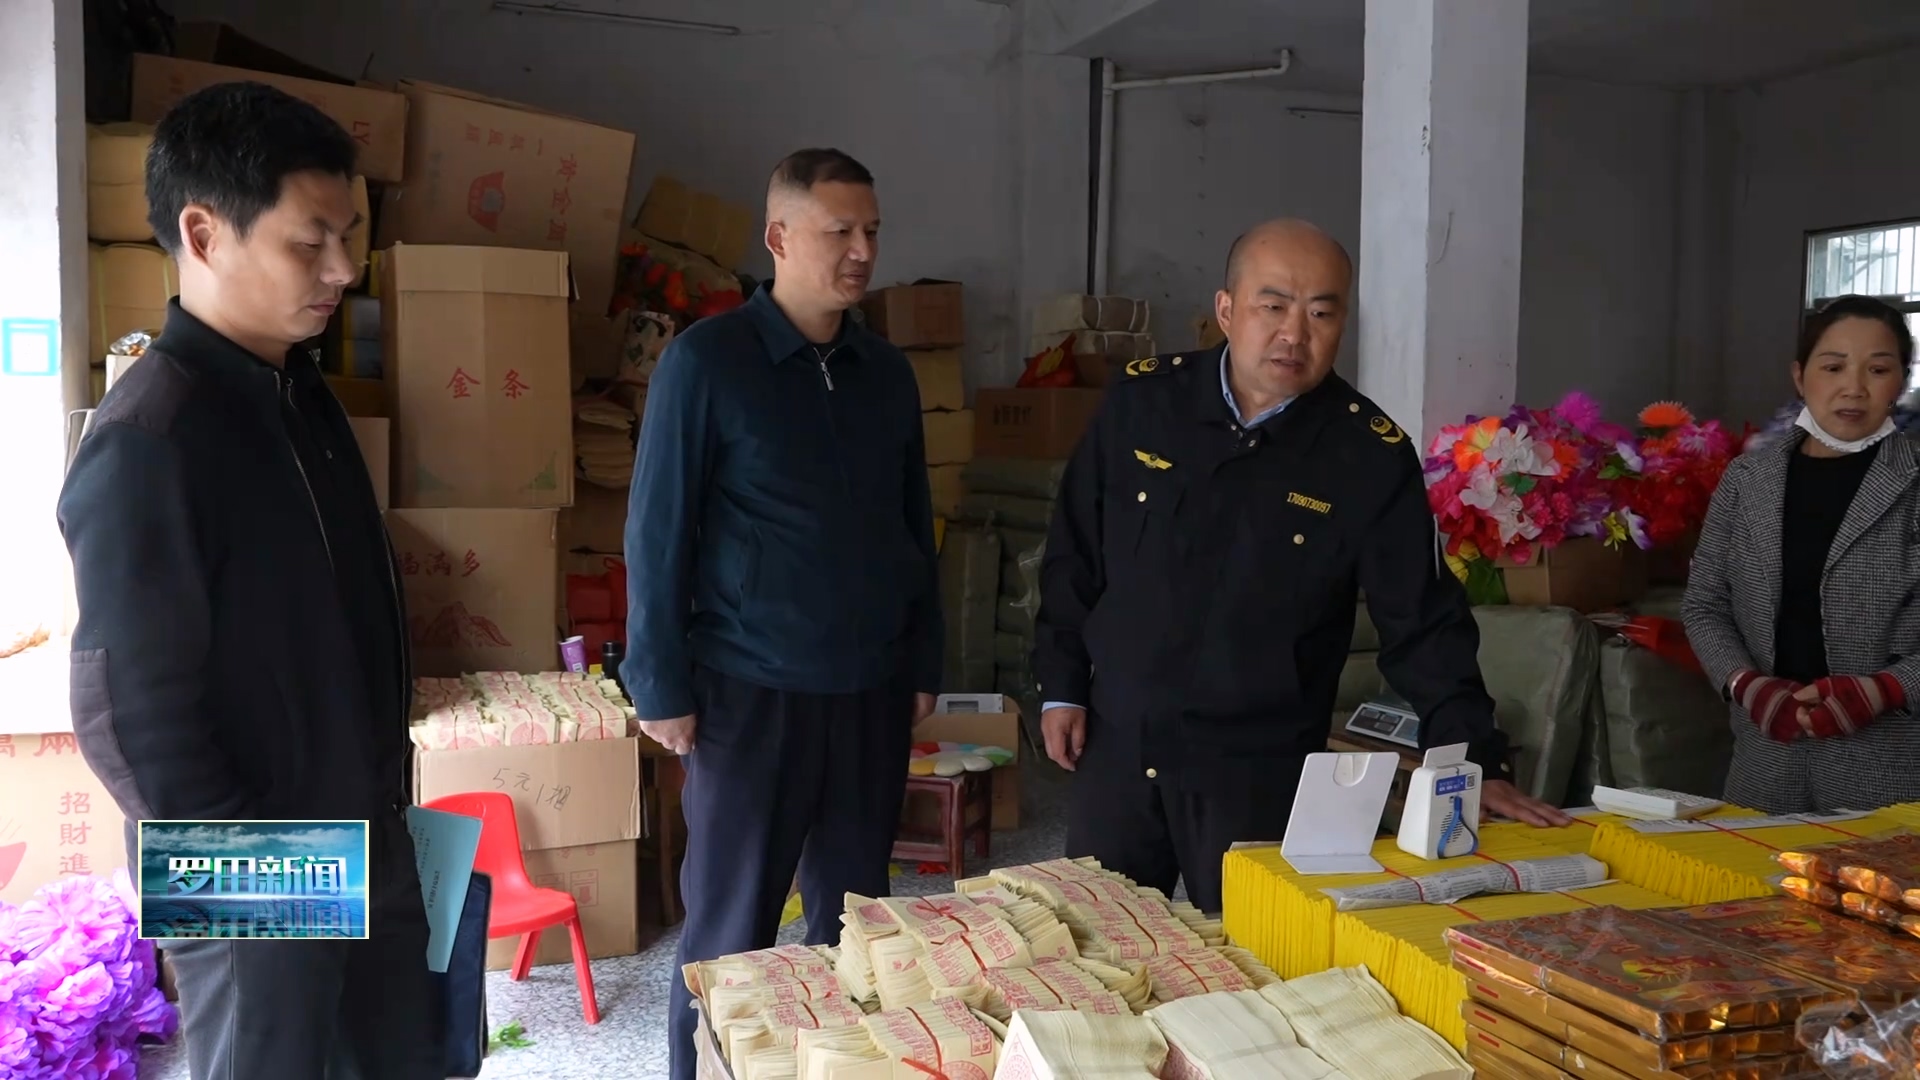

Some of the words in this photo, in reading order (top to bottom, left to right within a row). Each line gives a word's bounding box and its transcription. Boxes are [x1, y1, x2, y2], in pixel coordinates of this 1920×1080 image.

[445, 366, 531, 400] 金条
[57, 791, 93, 876] 招財進
